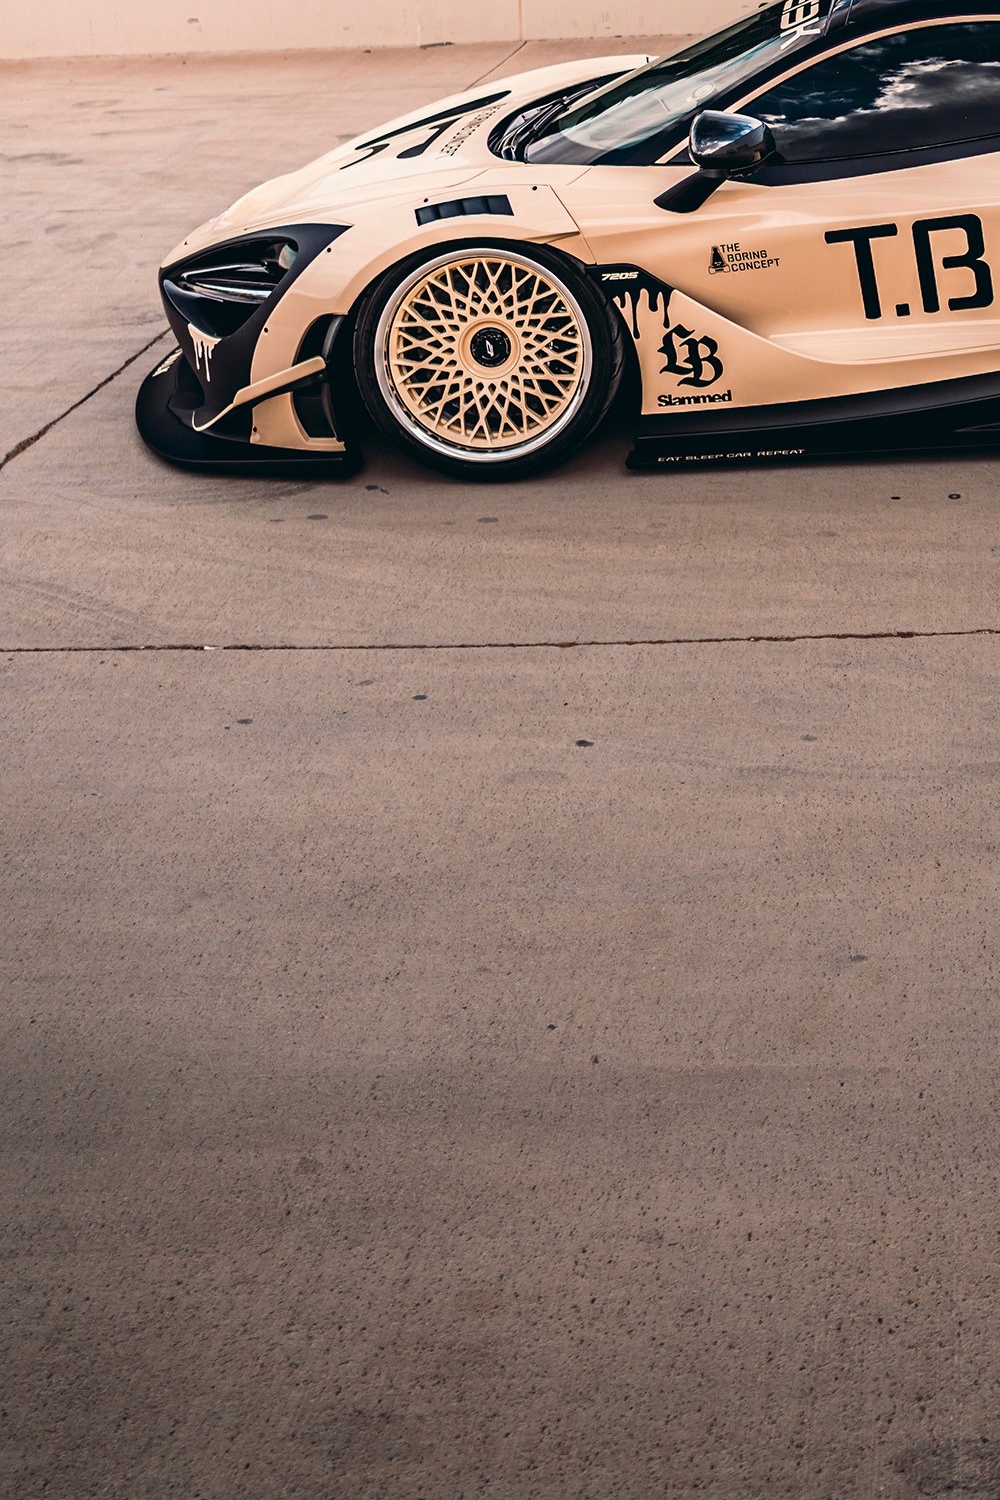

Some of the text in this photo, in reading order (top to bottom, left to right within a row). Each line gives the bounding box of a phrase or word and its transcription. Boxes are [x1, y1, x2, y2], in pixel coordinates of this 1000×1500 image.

[720, 243, 740, 253] THE
[727, 250, 767, 262] BORING
[731, 258, 780, 272] CONCEPT
[601, 271, 639, 281] 720S
[657, 390, 732, 407] Slammed
[757, 449, 805, 457] REPEAT
